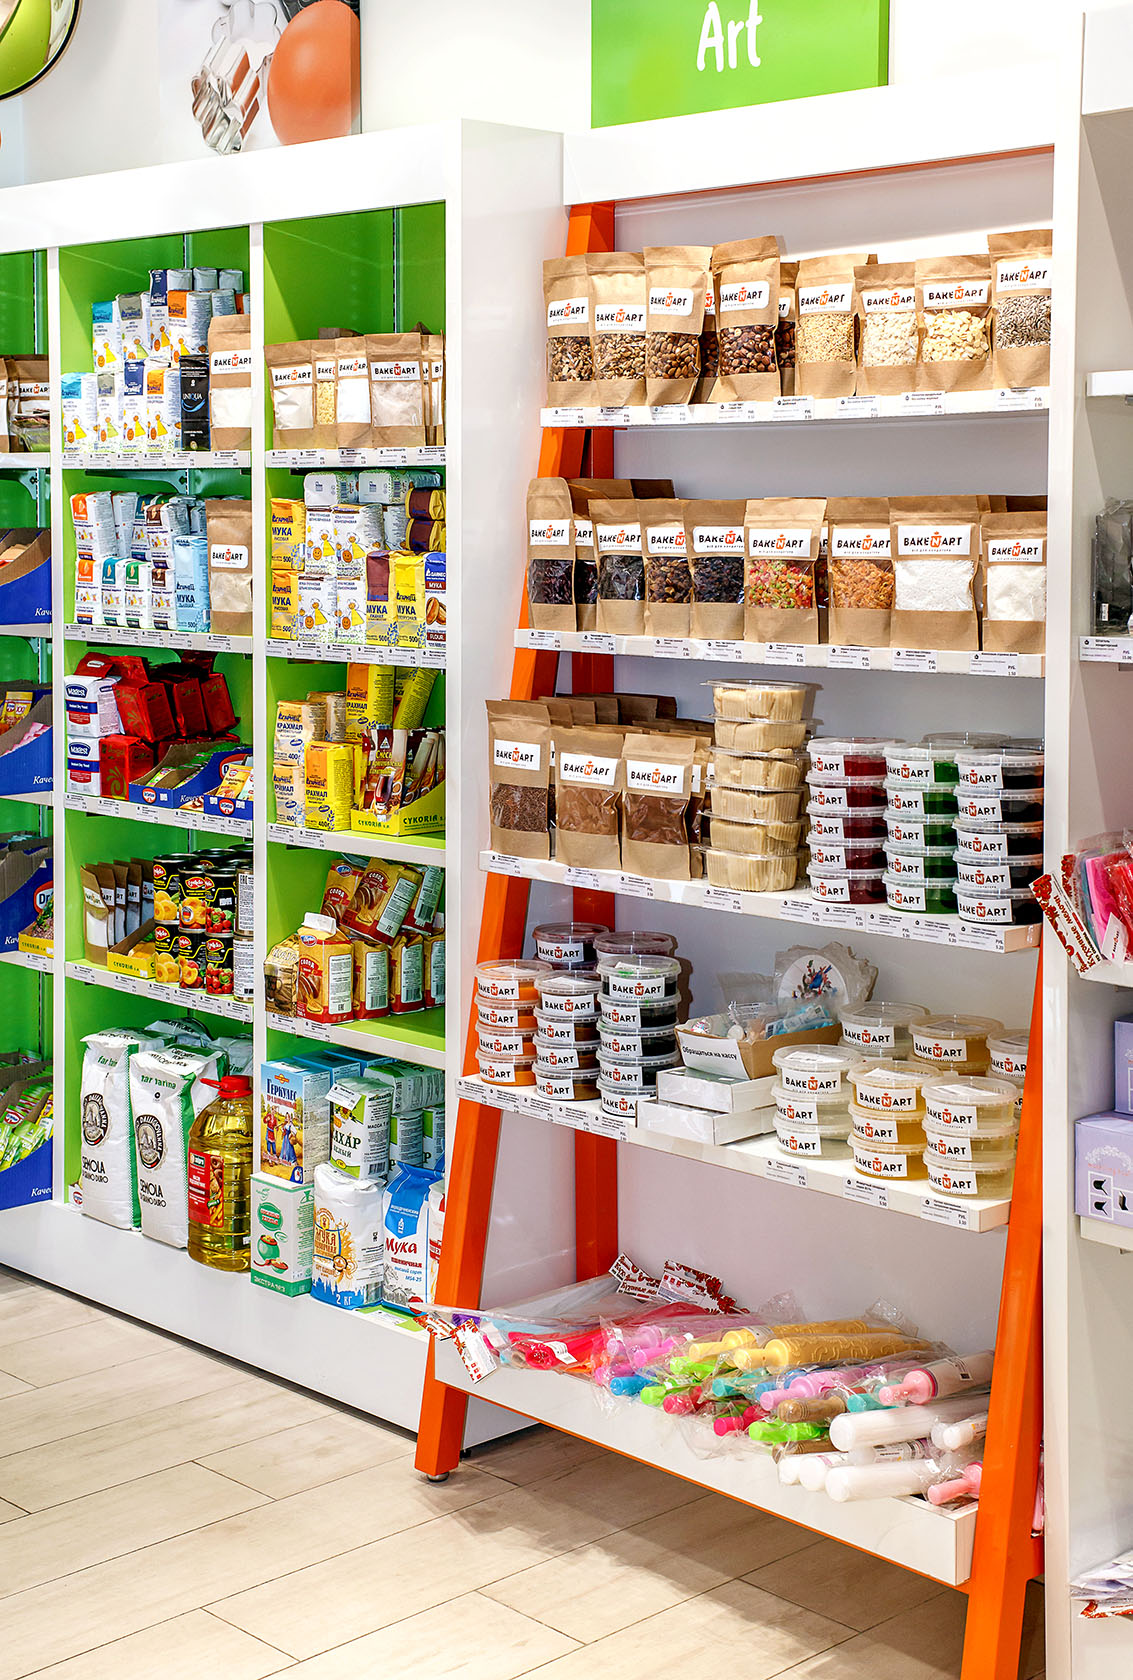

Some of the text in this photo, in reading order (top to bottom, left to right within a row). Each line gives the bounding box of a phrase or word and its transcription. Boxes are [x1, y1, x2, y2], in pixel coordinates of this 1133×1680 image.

[696, 0, 762, 72] Art
[403, 814, 438, 824] CYKORIA
[612, 983, 661, 996] BAKENART
[544, 1000, 591, 1012] BAKENART
[785, 1077, 838, 1090] BAKENART
[860, 1092, 912, 1107] BAKENART
[333, 1130, 361, 1149] АХАР
[336, 1294, 341, 1305] 2
